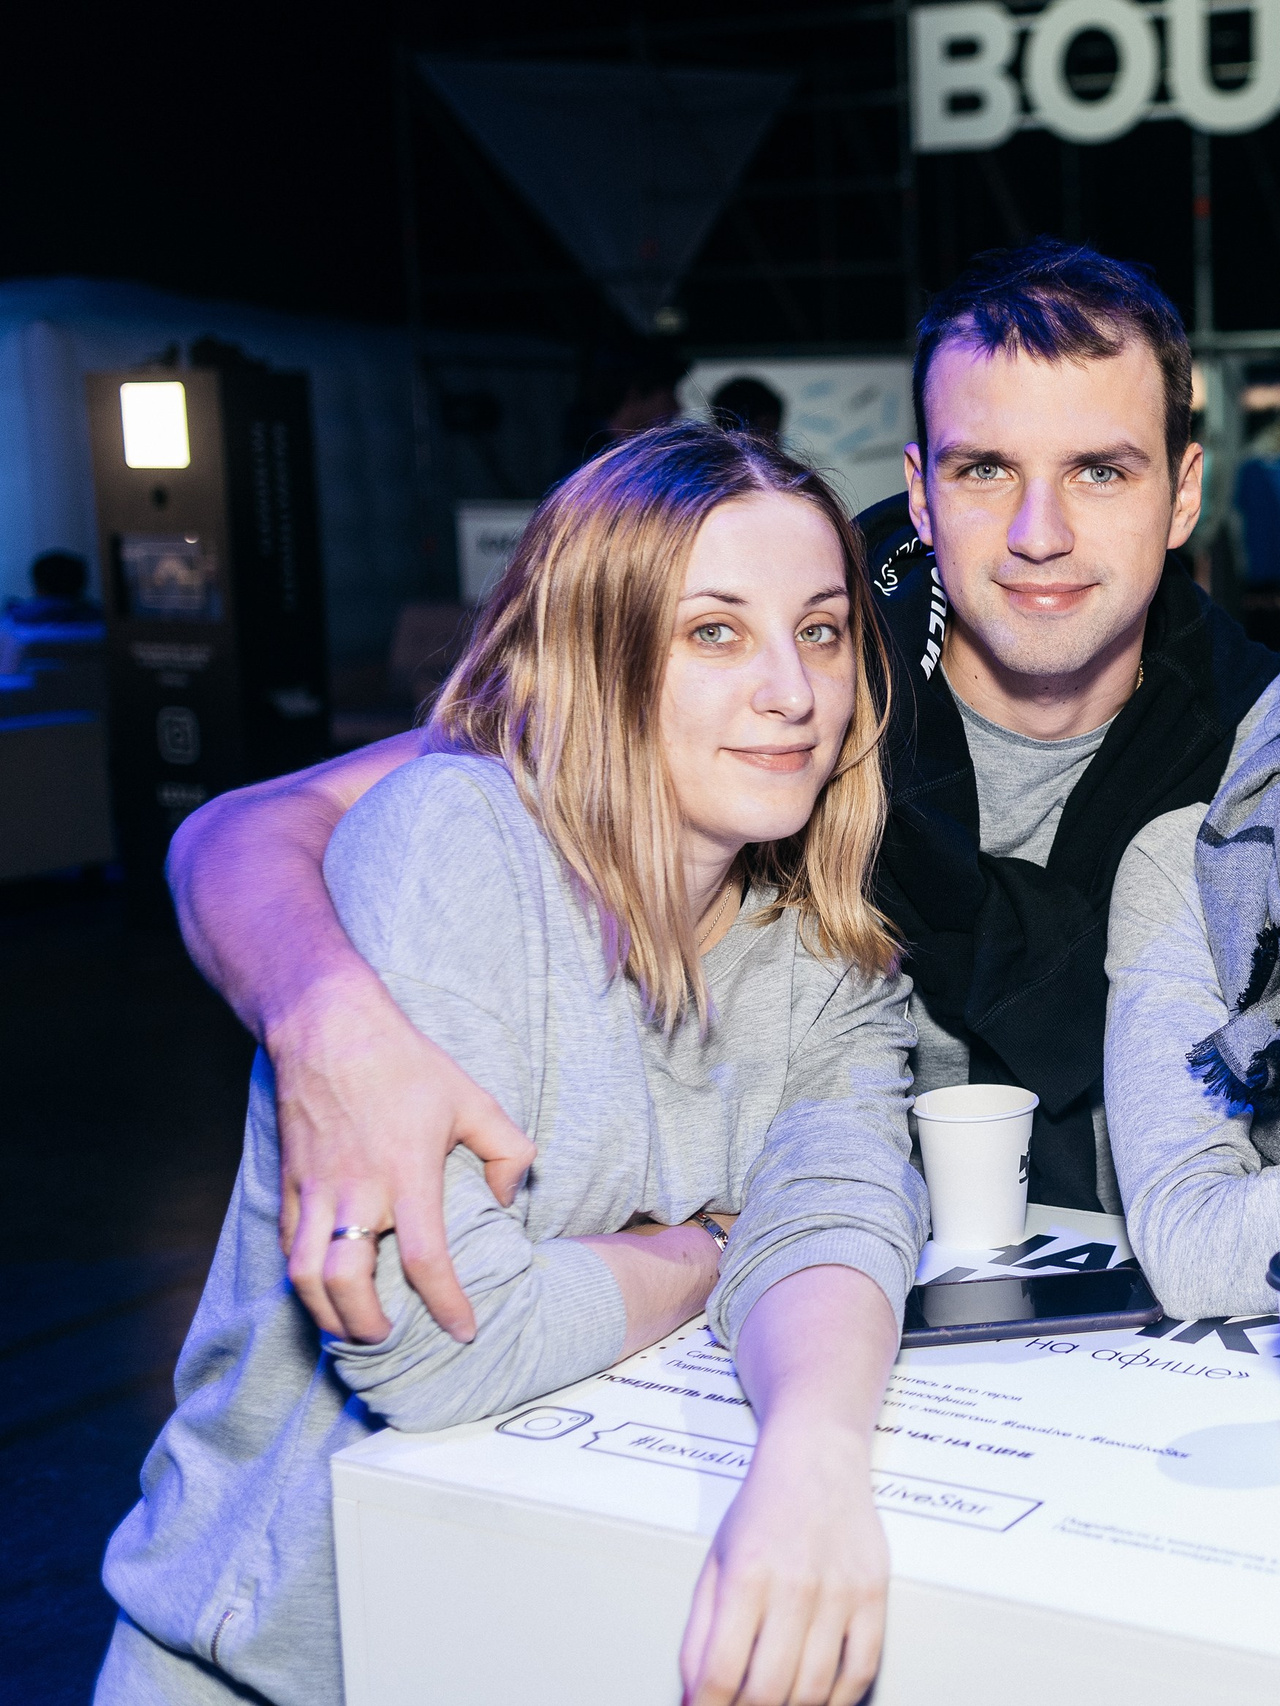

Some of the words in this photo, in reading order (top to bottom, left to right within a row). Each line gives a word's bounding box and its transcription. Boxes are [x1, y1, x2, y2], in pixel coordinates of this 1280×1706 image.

[1025, 1338, 1080, 1355] на
[1091, 1347, 1250, 1380] афише»
[597, 1373, 702, 1398] ПОБЕДИТЕЛЬ
[628, 1435, 751, 1468] #LexusLiv
[906, 1430, 943, 1443] ЧАС
[943, 1437, 971, 1449] НА
[975, 1443, 1035, 1459] СЦЕНЕ
